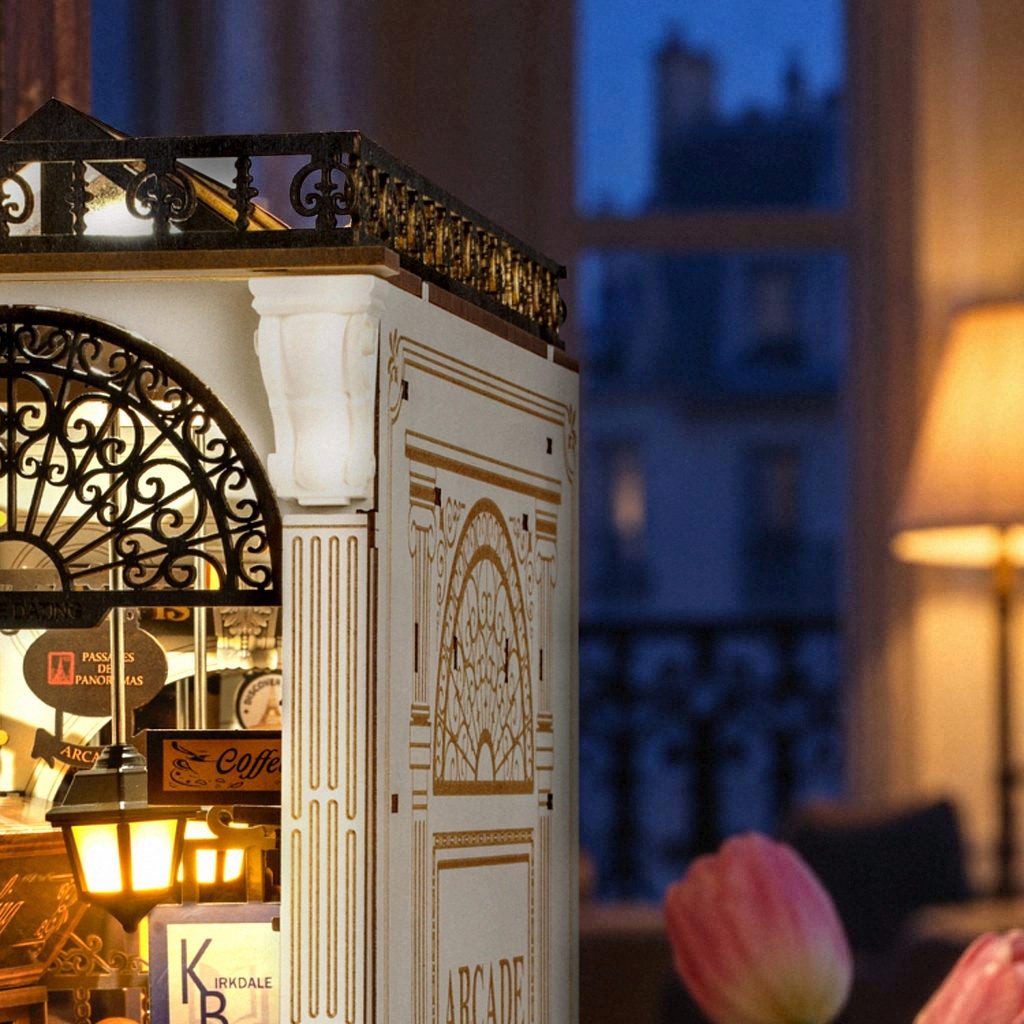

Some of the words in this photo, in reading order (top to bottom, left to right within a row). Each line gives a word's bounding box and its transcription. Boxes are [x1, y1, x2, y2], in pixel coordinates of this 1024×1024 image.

[82, 652, 135, 663] PASSAES
[97, 664, 112, 674] DE
[75, 675, 144, 685] PANORMAS
[60, 745, 101, 763] ARCA
[216, 748, 280, 779] Coffe
